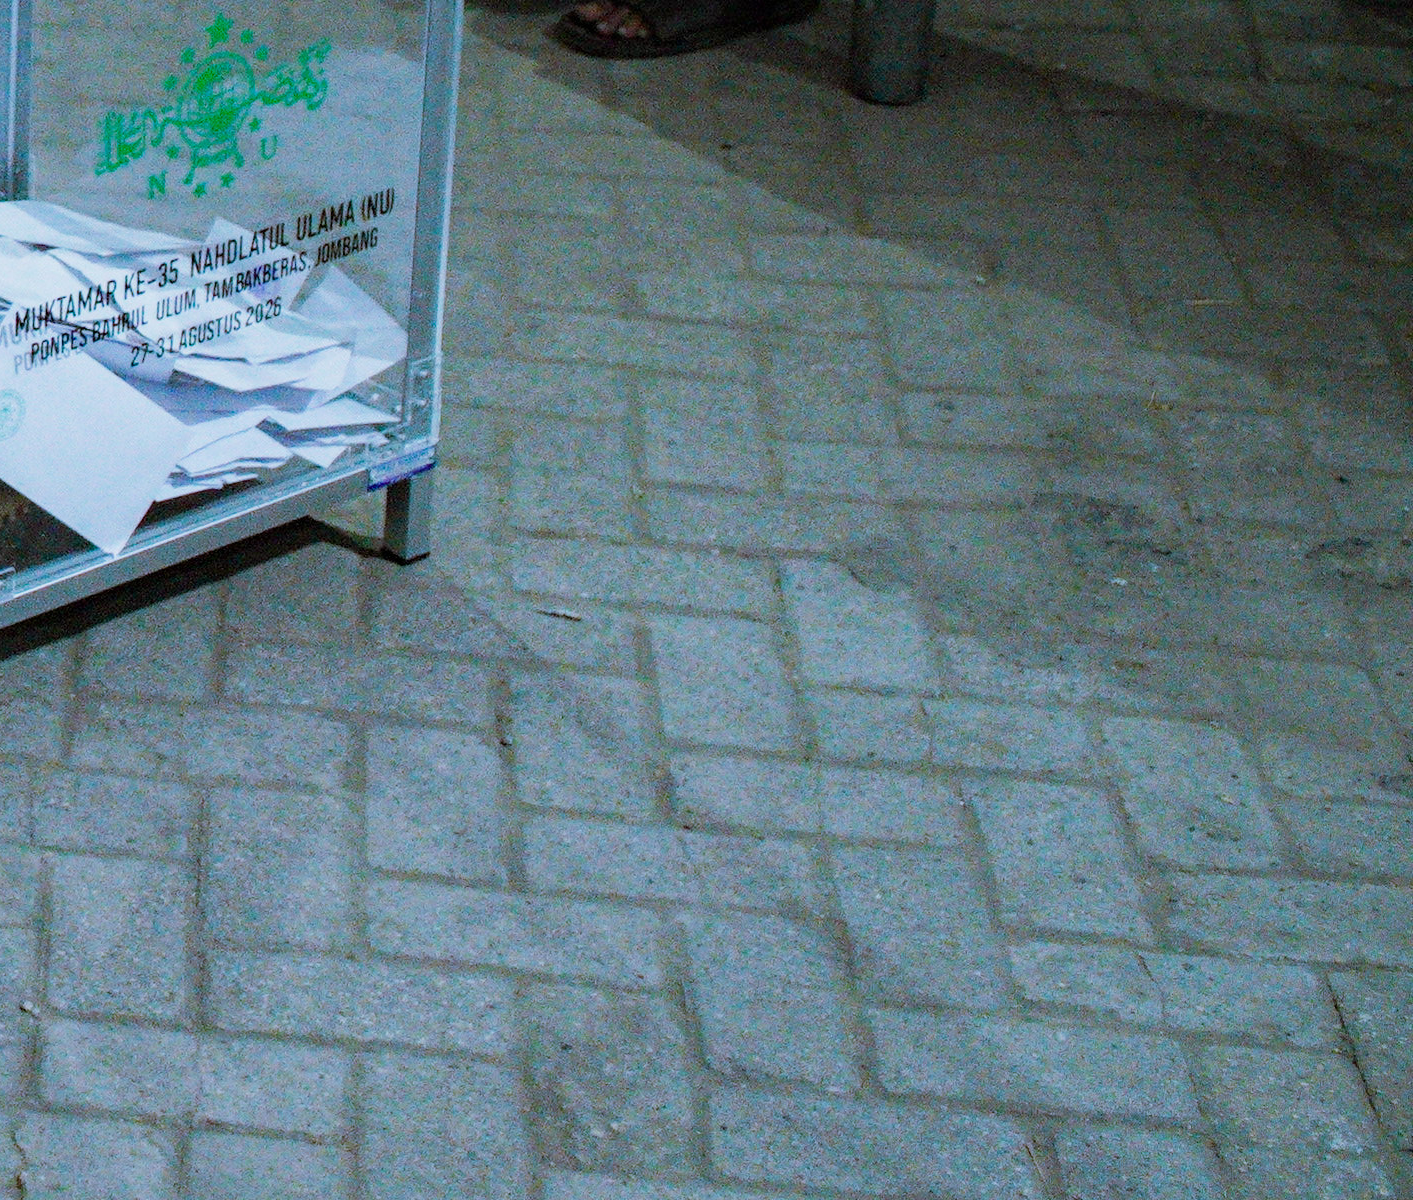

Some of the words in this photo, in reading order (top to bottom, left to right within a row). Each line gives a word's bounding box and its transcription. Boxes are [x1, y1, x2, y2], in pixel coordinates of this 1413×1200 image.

[147, 171, 166, 199] N
[14, 280, 118, 337] MUKTAMAR
[123, 257, 179, 301] KE-35
[189, 222, 289, 278] NAHDLATUL
[295, 200, 356, 243] ULAMA
[360, 187, 396, 224] (NU)
[30, 325, 88, 363] PONPES
[92, 304, 149, 343] BAHRUL
[154, 288, 202, 322] ULUM,
[203, 251, 312, 305] TAMBAKBERAS,
[314, 226, 379, 268] JOMBANG
[130, 332, 175, 368] 27-31
[178, 308, 243, 350] AGUSTUS
[245, 296, 283, 329] 2026
